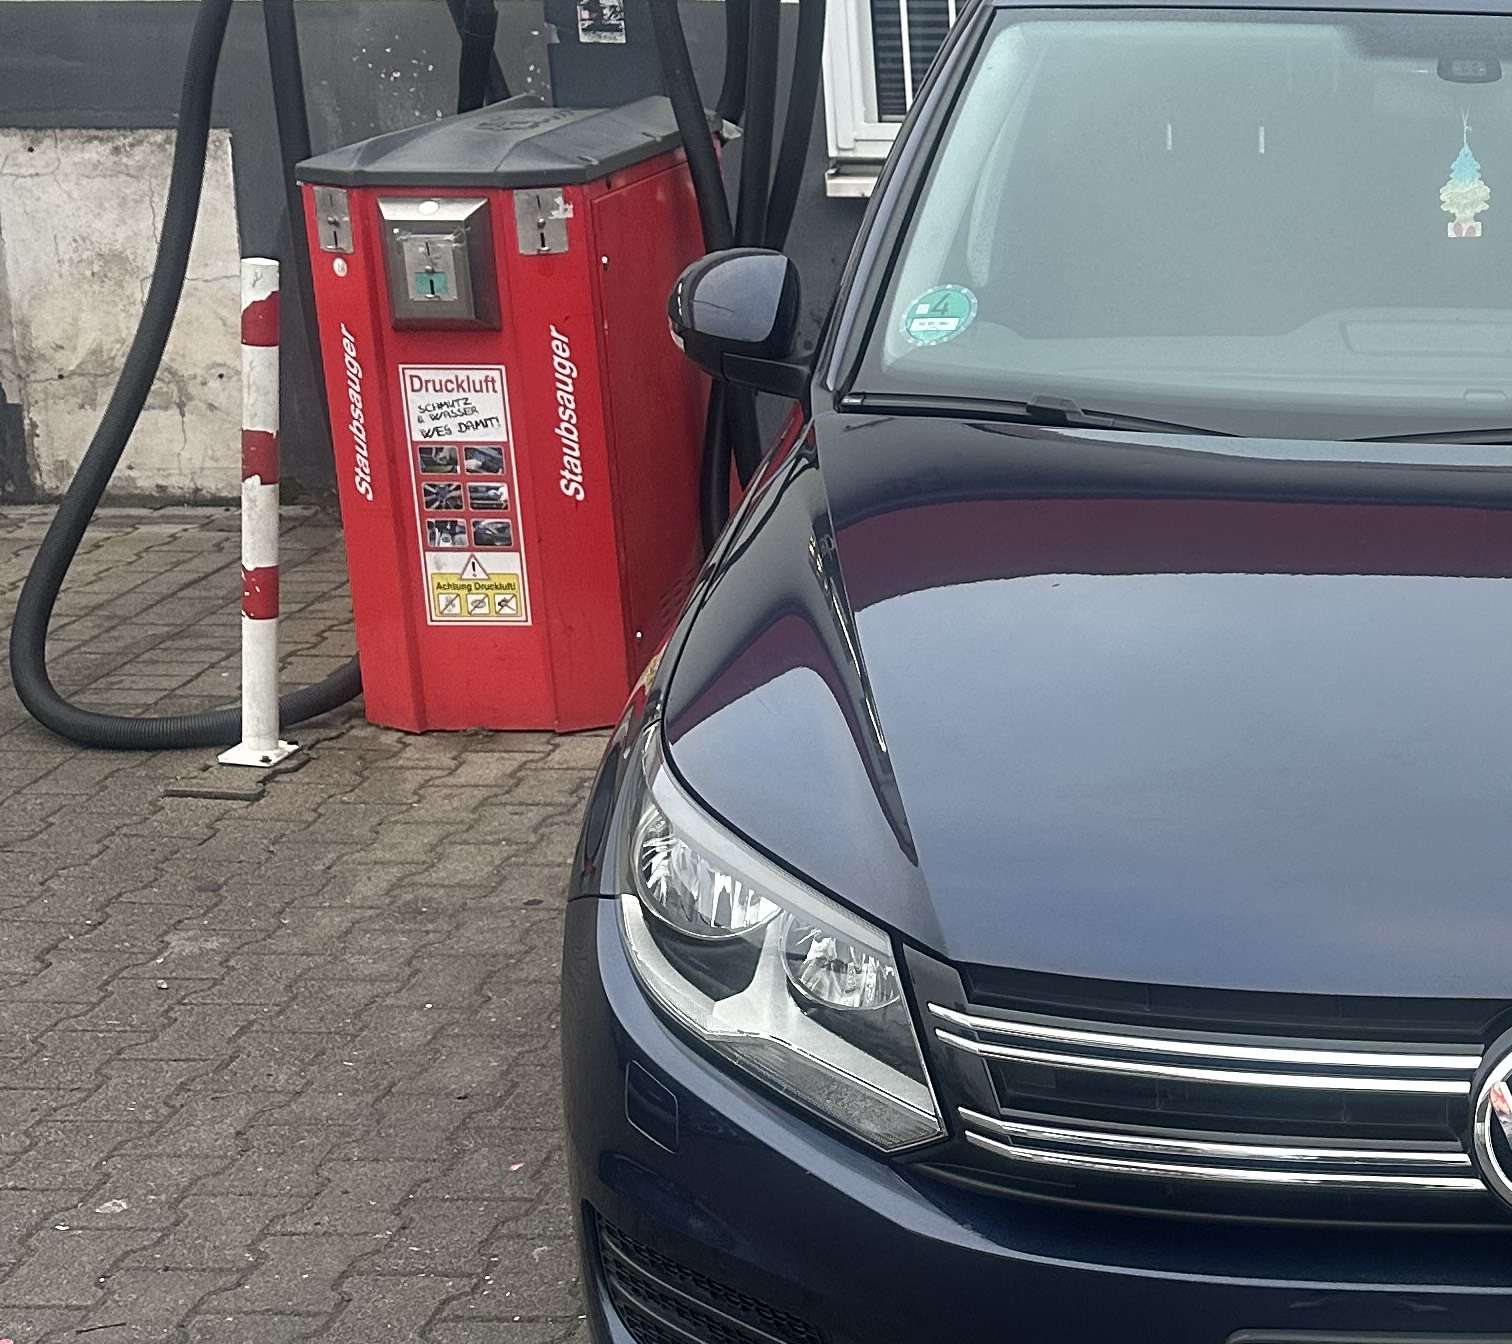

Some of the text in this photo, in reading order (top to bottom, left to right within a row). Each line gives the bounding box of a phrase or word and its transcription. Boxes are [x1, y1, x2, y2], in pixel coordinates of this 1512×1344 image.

[930, 292, 951, 316] 4
[409, 374, 498, 393] Druckluft
[340, 322, 373, 502] Staubsauger
[428, 405, 479, 422] WASSER
[549, 324, 585, 502] Staubsauger
[436, 581, 516, 592] Achtung Druckluft!
